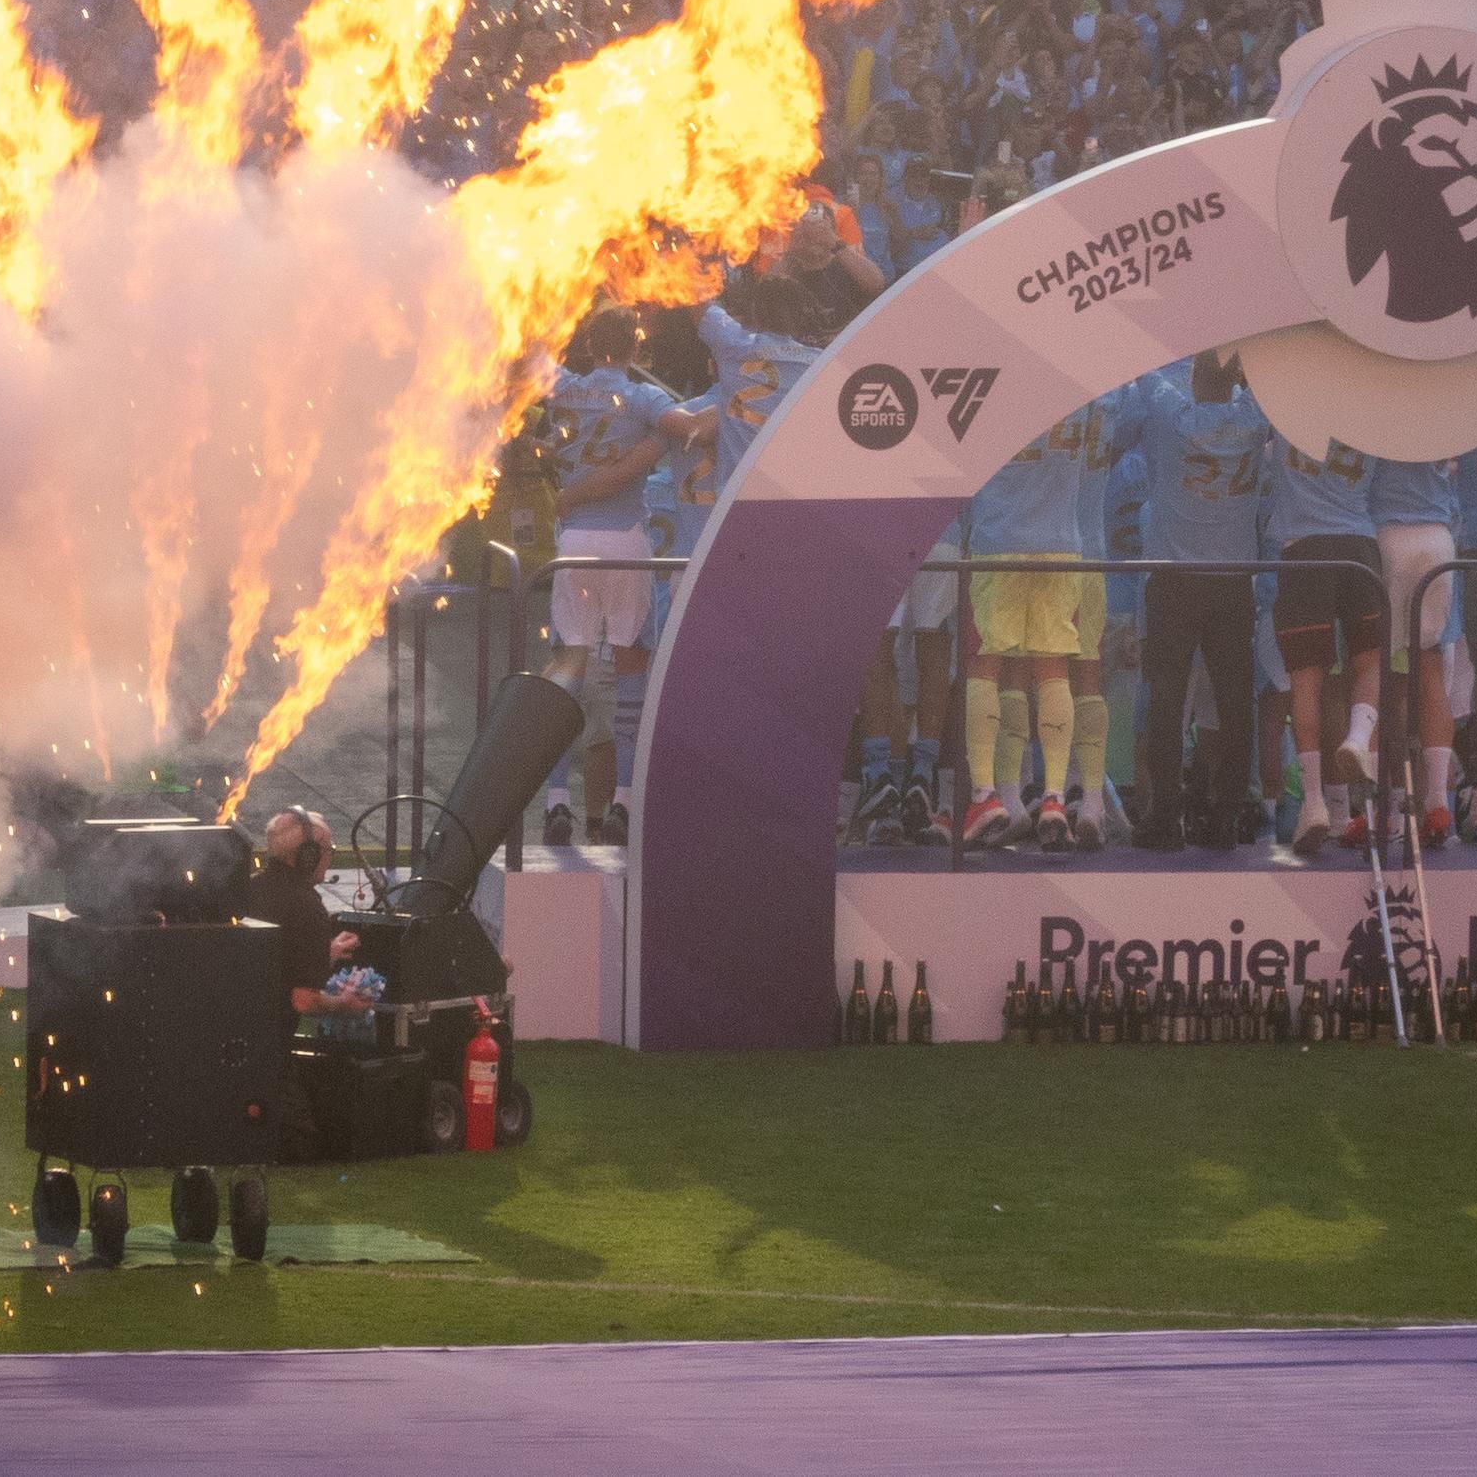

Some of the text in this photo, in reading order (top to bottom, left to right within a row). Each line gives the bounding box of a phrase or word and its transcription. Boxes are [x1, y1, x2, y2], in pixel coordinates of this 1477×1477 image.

[1017, 191, 1226, 304] CHAMPIONS
[1067, 236, 1193, 314] 2023/24
[850, 412, 906, 427] SPORTS
[851, 382, 905, 412] EA
[1039, 915, 1321, 986] Premier
